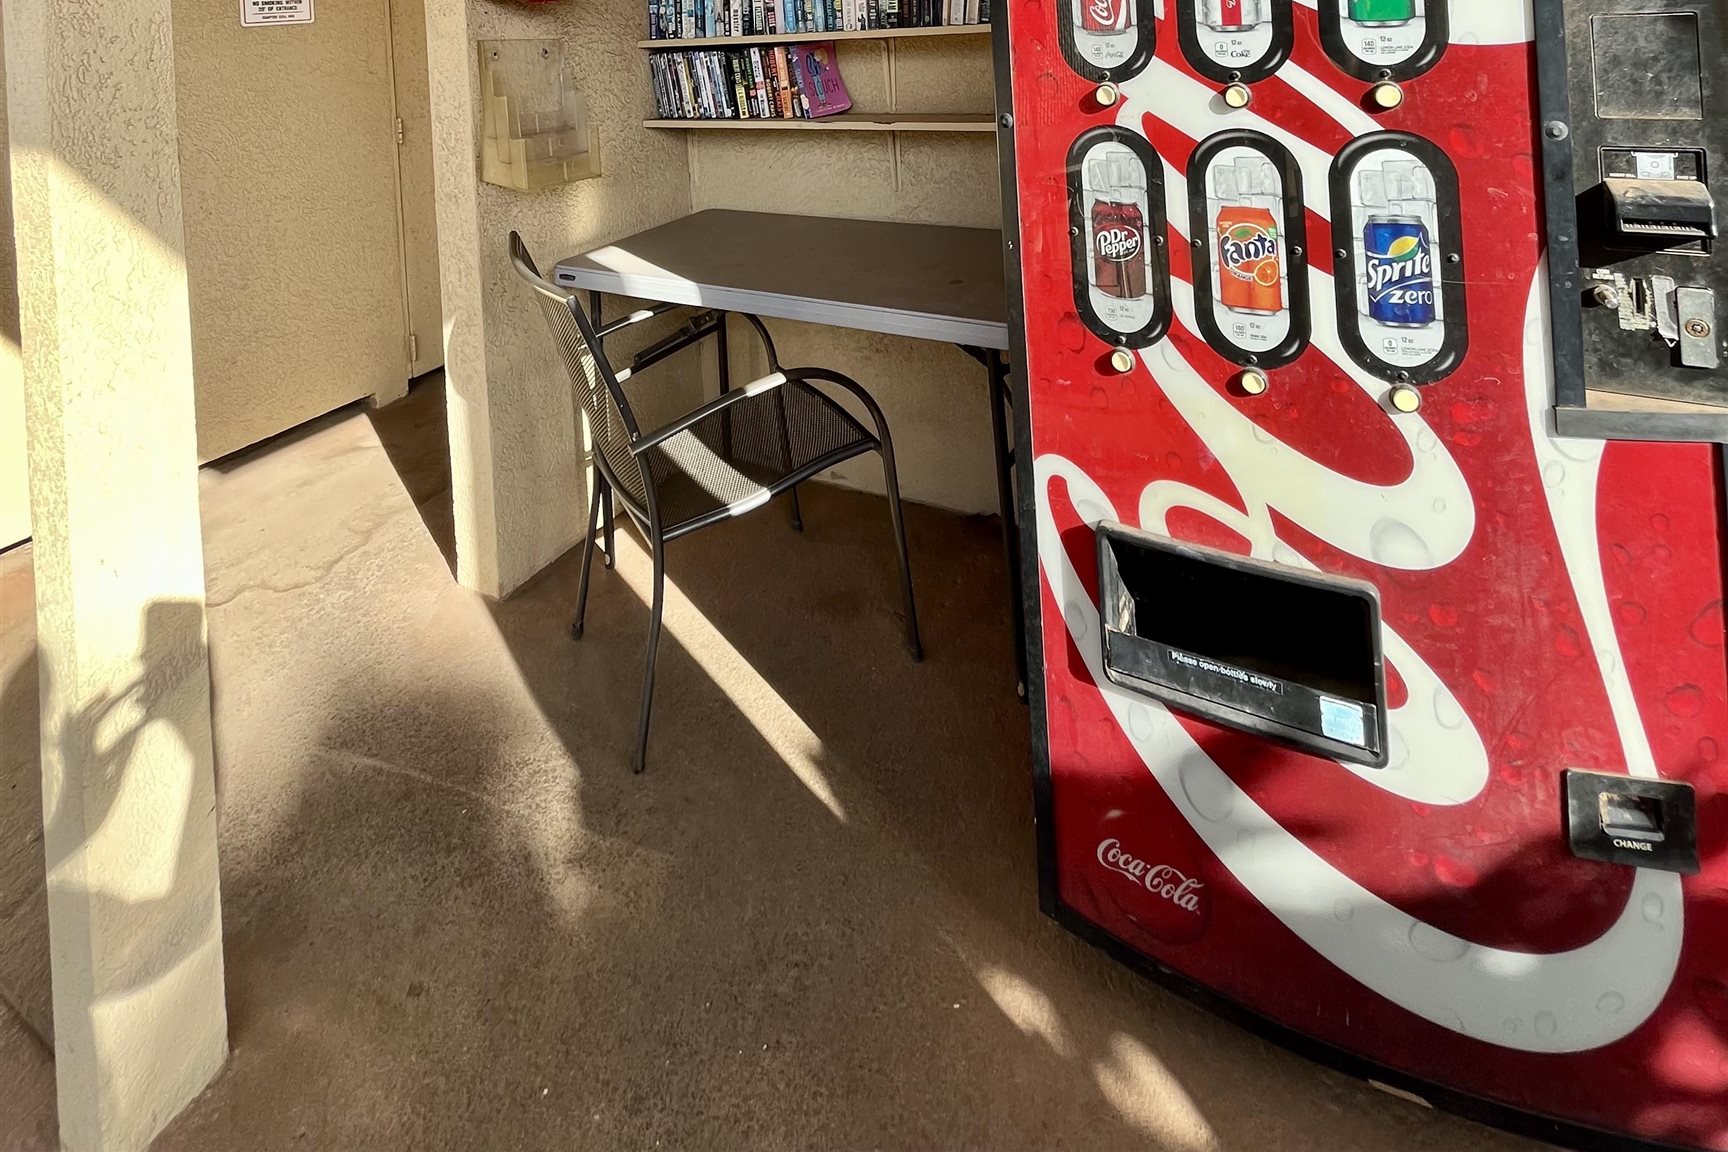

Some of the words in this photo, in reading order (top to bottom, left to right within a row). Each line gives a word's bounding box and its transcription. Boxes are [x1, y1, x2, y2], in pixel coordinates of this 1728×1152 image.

[768, 50, 777, 77] ROBERT
[765, 79, 773, 101] ROBERT
[1100, 230, 1138, 258] Pepper
[1110, 229, 1128, 244] Dr
[1367, 250, 1430, 291] Sprite
[1389, 288, 1433, 305] zero
[1171, 650, 1198, 666] Please
[1199, 661, 1219, 673] open
[1249, 675, 1277, 692] slowly
[1613, 838, 1653, 852] CHANGE
[1096, 838, 1205, 911] Coca-Cola
